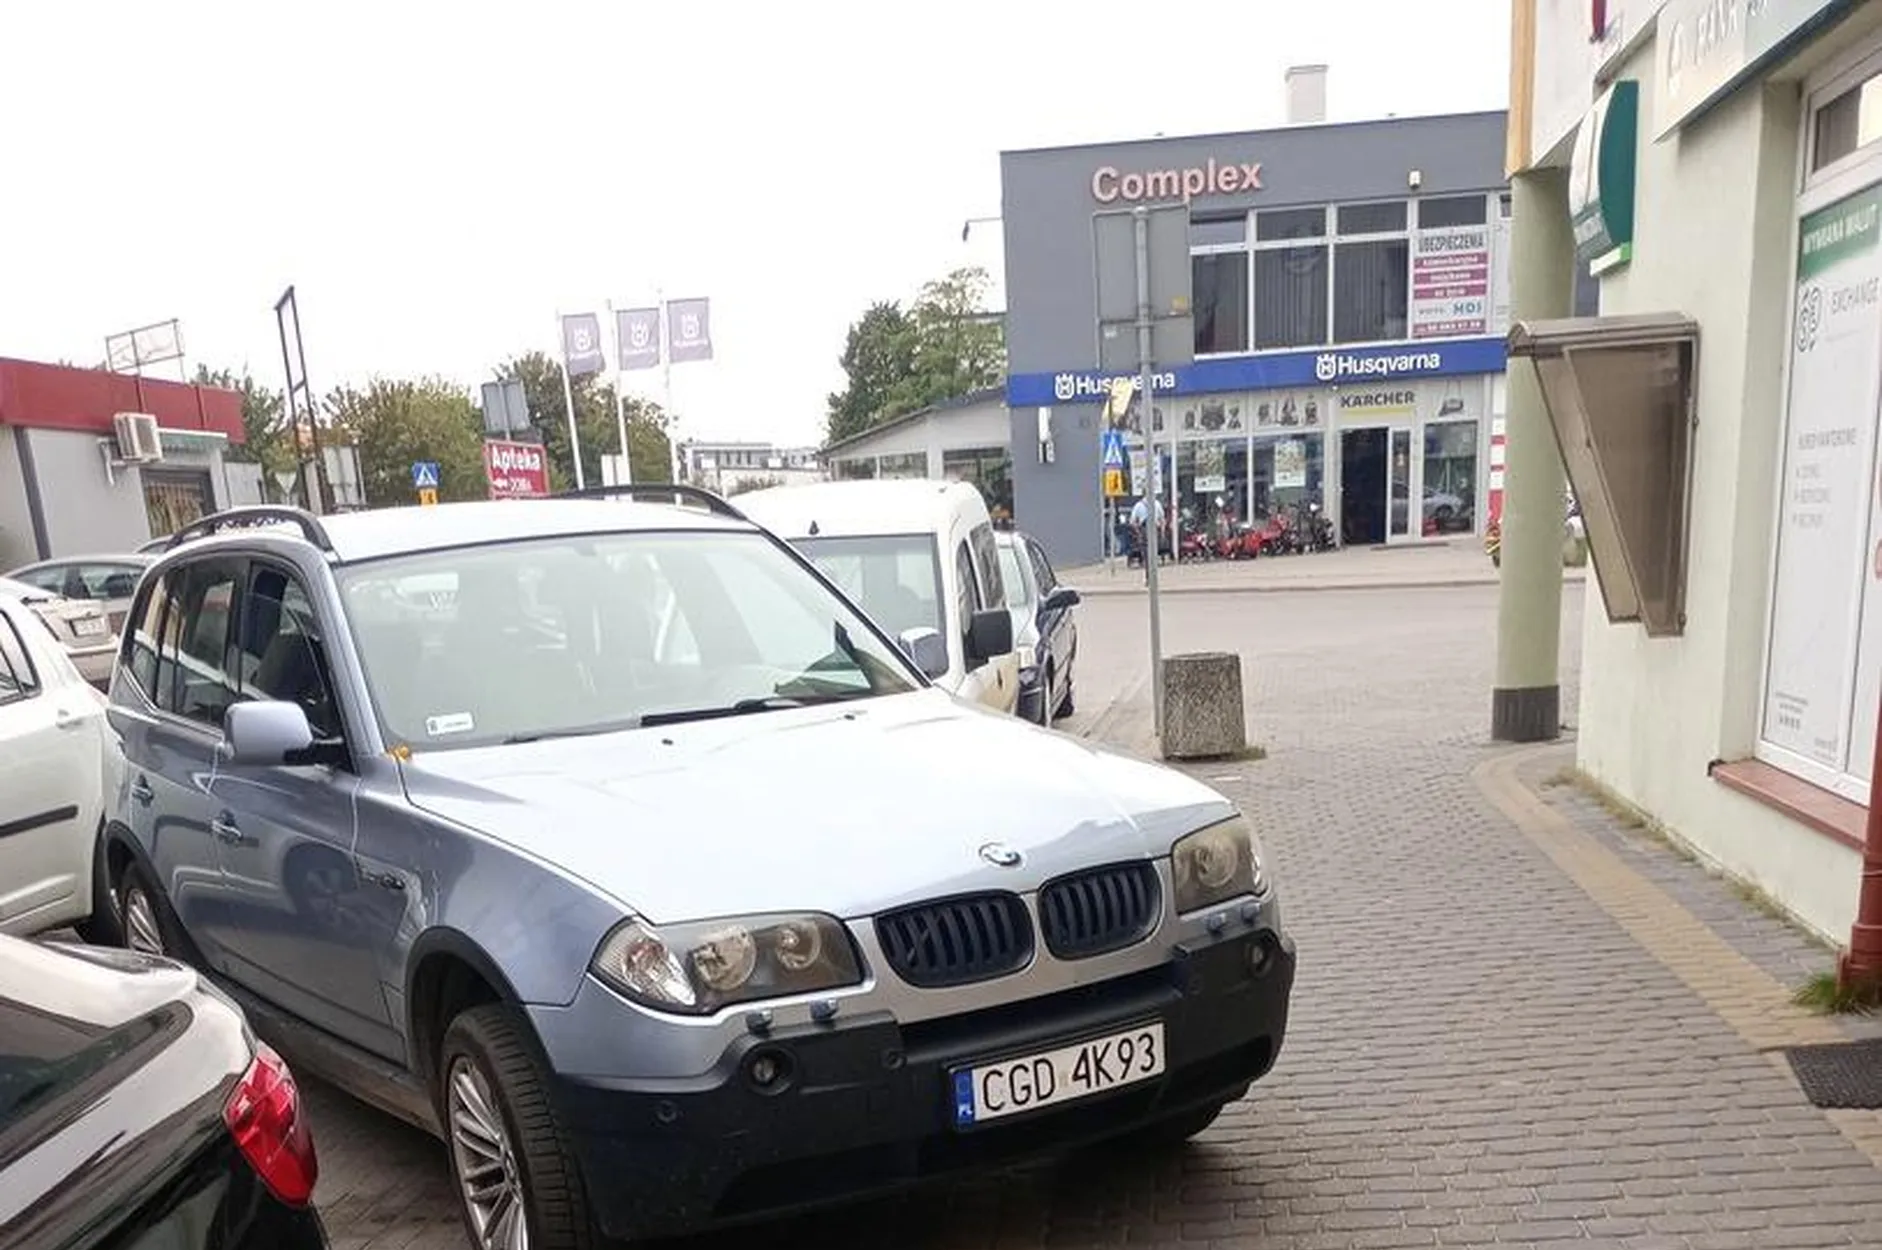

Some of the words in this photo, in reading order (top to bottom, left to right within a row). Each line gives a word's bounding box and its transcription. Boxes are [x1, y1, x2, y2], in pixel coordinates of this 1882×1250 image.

[1092, 157, 1262, 203] Complex
[1338, 353, 1440, 375] Husqvarna
[492, 445, 540, 475] Apteka
[982, 1058, 1055, 1111] CGD
[1071, 1033, 1155, 1089] 4K93
